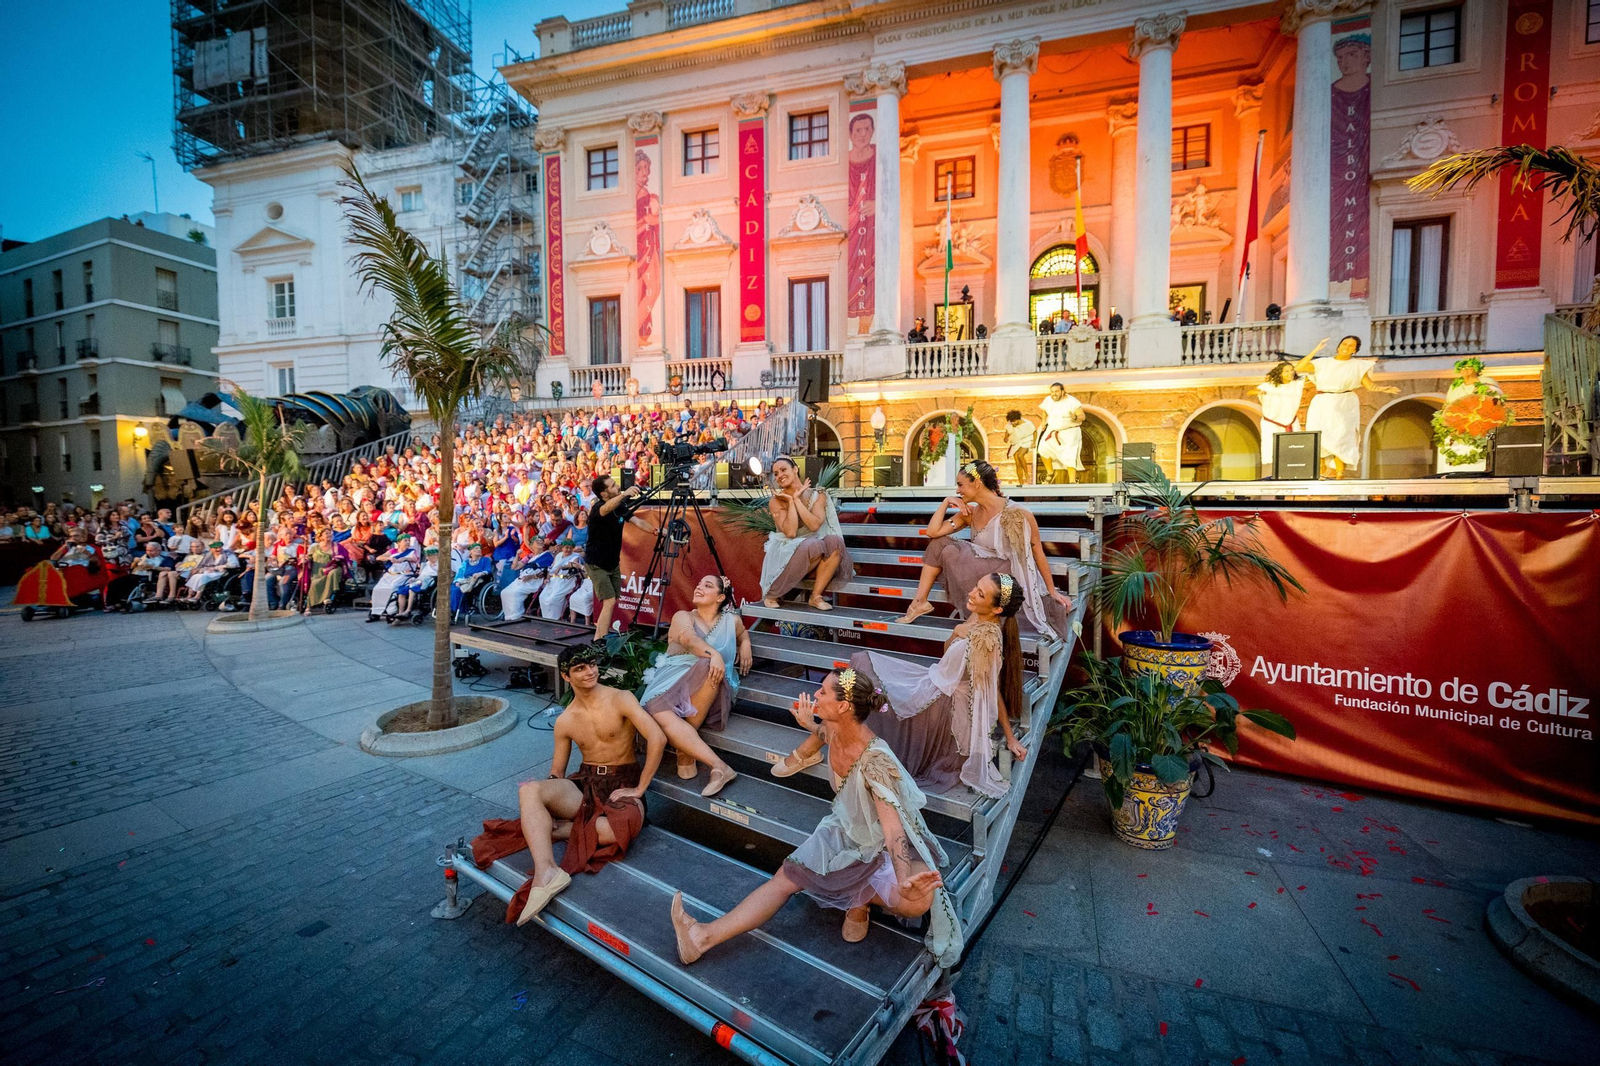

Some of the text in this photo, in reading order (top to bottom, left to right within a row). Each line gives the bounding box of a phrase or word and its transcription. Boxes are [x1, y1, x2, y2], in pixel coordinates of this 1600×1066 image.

[975, 18, 987, 27] DE
[990, 15, 1003, 24] LA
[1028, 4, 1055, 17] NOBLE
[1344, 106, 1357, 272] BALBO MENOR
[745, 165, 759, 289] CÁDIZ
[857, 172, 867, 310] BALBO MAYOR
[838, 628, 861, 640] Cultura
[1250, 655, 1433, 699] Ayuntamiento
[1439, 676, 1479, 705] de
[1487, 681, 1590, 720] Cádiz
[1334, 693, 1593, 741] Fundación Municipal de Cultura
